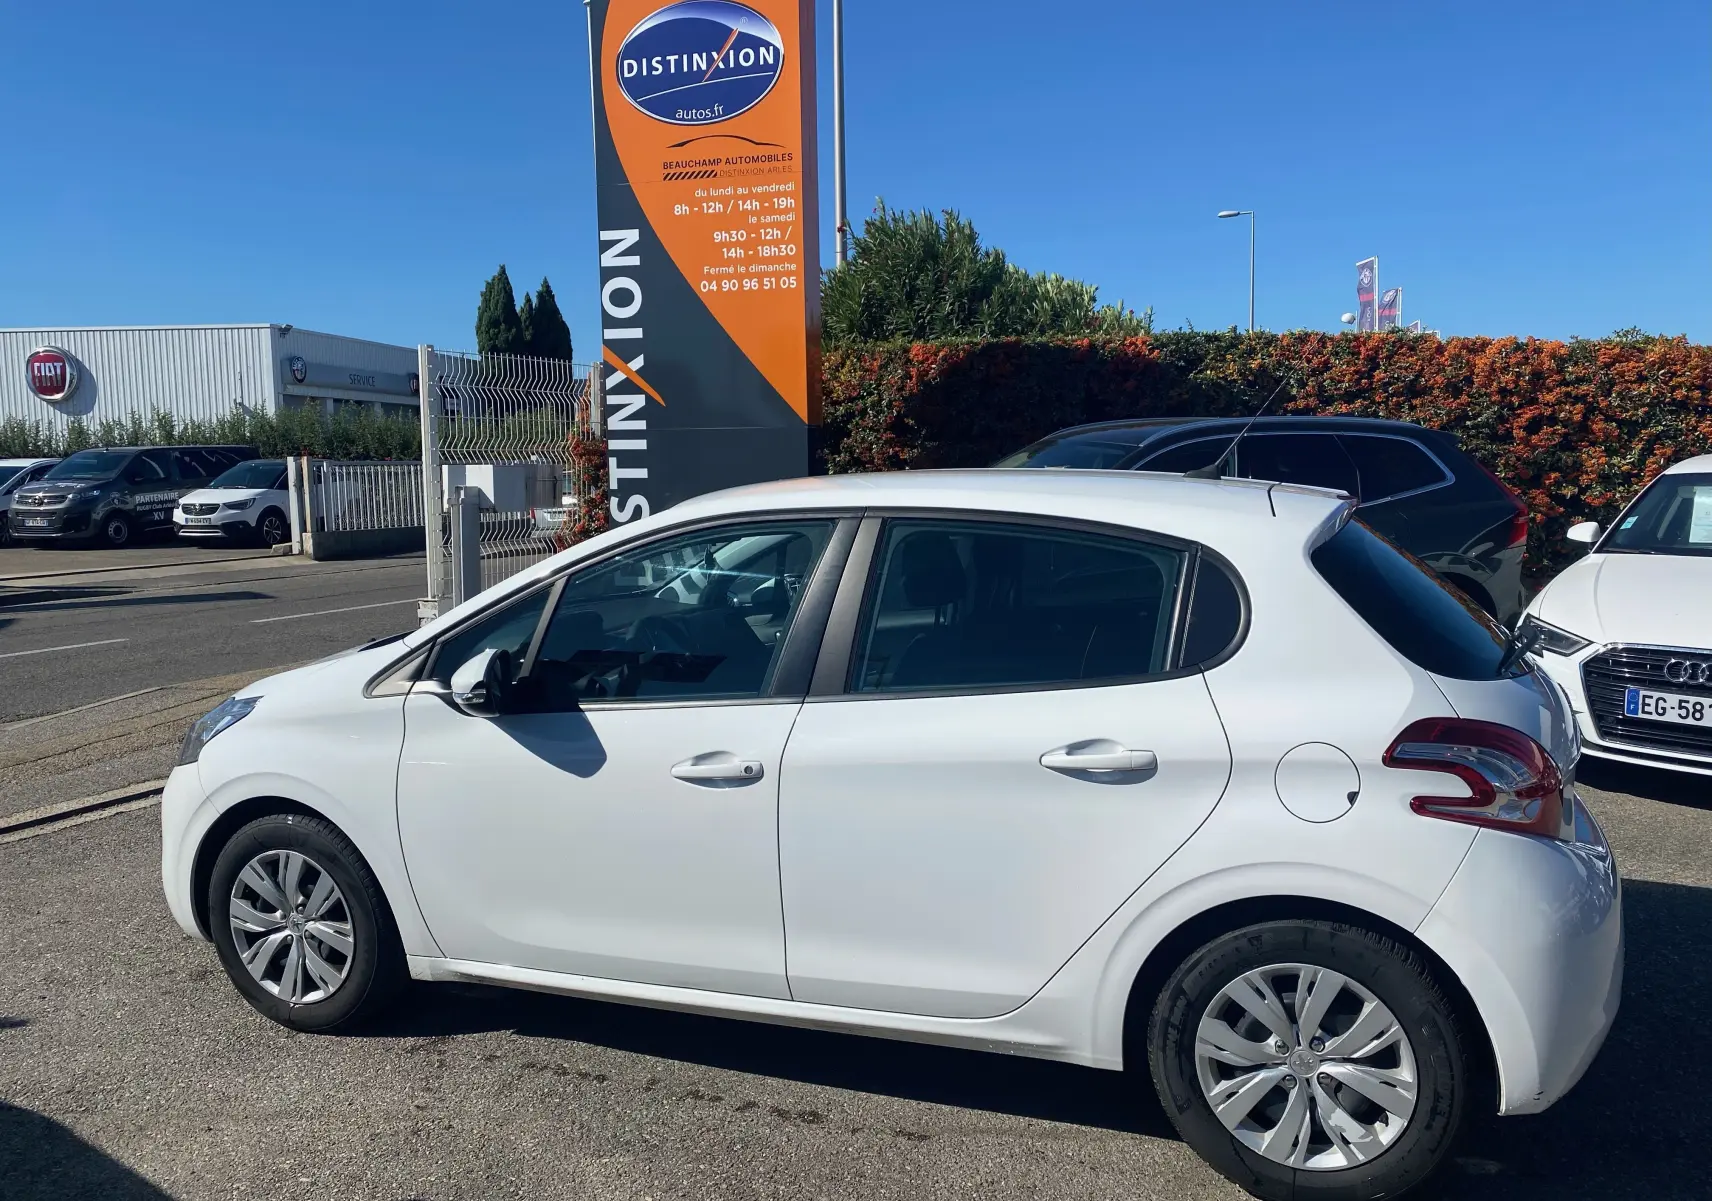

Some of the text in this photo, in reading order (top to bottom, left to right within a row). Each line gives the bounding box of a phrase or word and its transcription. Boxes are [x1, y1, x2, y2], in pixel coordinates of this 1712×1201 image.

[623, 42, 774, 80] DISTINXION
[675, 103, 724, 120] autos.fr
[662, 152, 793, 170] BEAUCHAMP AUTOMOBILES
[719, 167, 765, 177] DISTINXION
[694, 181, 795, 198] du lundi au vendredi
[673, 204, 690, 216] 8h
[701, 202, 723, 214] 12h
[726, 200, 734, 214] /
[737, 199, 760, 212] 14h
[772, 197, 795, 209] 19h
[748, 212, 796, 224] le samedi
[713, 229, 747, 243] 9h30
[759, 227, 781, 240] 12h
[722, 246, 744, 259] 14h
[757, 244, 796, 258] 18h30
[703, 261, 797, 275] Fermé le dimanche
[700, 276, 797, 293] 04 90 96 51 05
[33, 361, 63, 387] FIAT
[349, 373, 376, 388] SERVICE
[135, 491, 179, 504] PARTENAIRE
[153, 511, 165, 521] XV
[1641, 694, 1712, 722] EG-58
